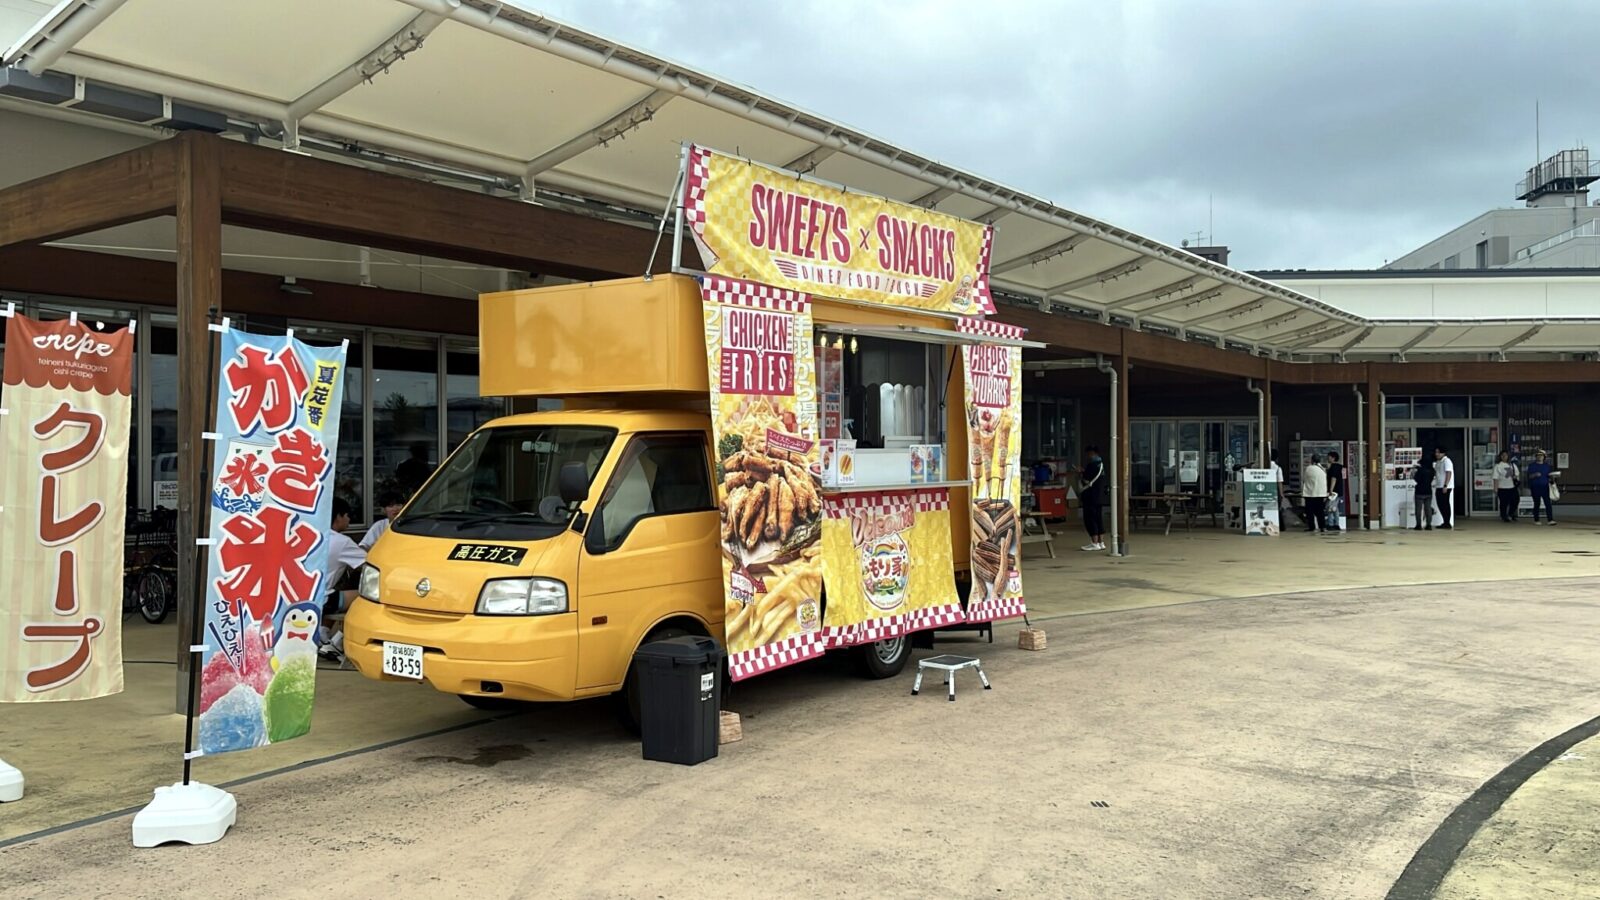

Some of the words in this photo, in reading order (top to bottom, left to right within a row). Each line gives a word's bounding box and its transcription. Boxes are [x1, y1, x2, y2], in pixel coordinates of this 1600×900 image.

[750, 182, 850, 264] SWEETS
[876, 213, 956, 283] SNACKS
[801, 265, 842, 281] DINER
[848, 272, 880, 290] FOOD
[885, 278, 920, 297] TRUCK
[33, 332, 114, 360] crepe
[729, 310, 788, 352] CHICKEN
[721, 352, 731, 389] FRENCH
[731, 352, 788, 392] FRIES
[969, 345, 1008, 375] CREPES
[307, 365, 337, 426] 夏定番
[1508, 417, 1528, 426] Rest
[1529, 417, 1552, 426] Room
[217, 344, 329, 622] かき氷
[219, 453, 269, 497] 氷
[24, 401, 104, 689] クレープ
[455, 545, 518, 562] 高圧ガス
[869, 556, 902, 578] もり家
